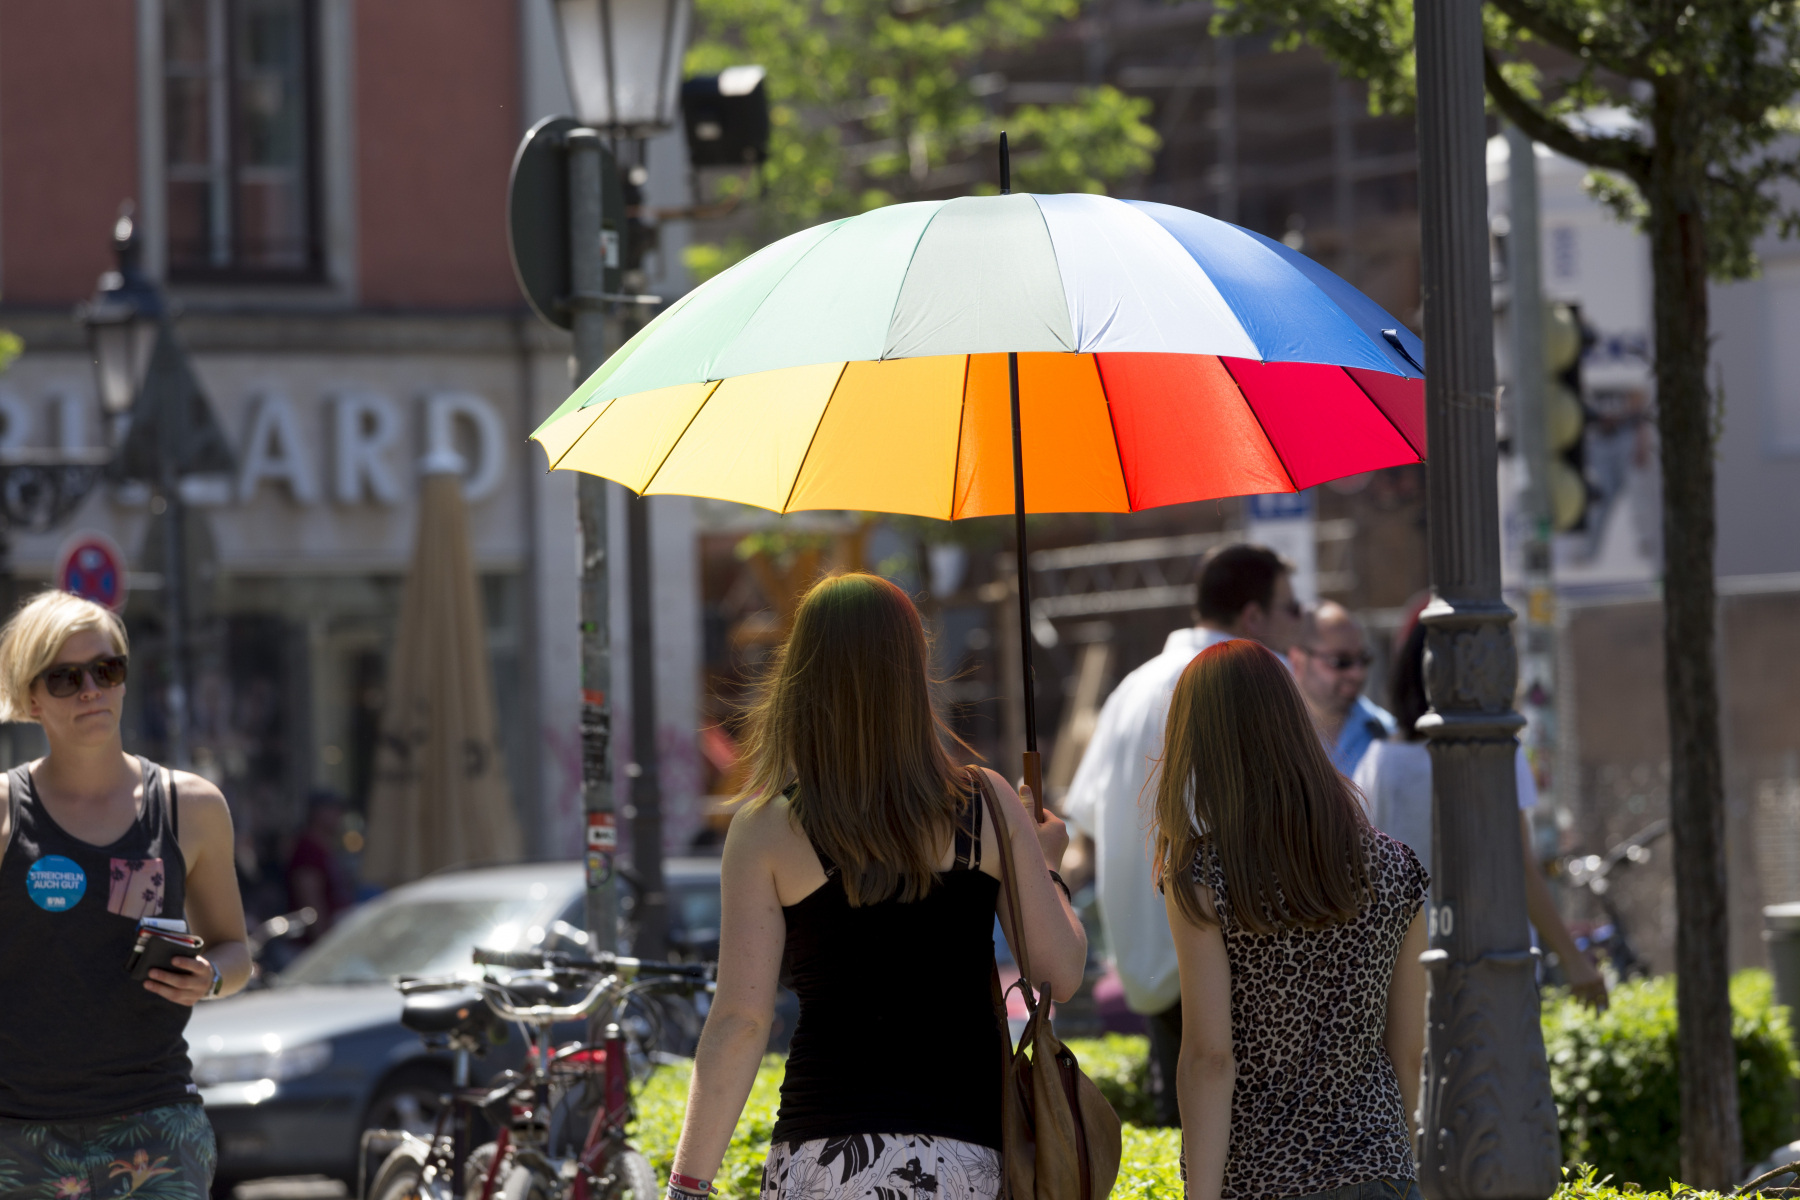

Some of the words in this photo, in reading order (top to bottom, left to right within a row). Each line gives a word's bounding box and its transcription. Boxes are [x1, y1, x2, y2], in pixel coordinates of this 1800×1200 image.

[30, 871, 84, 882] STREICHELN
[33, 880, 60, 889] AUCH
[61, 881, 80, 889] GUT
